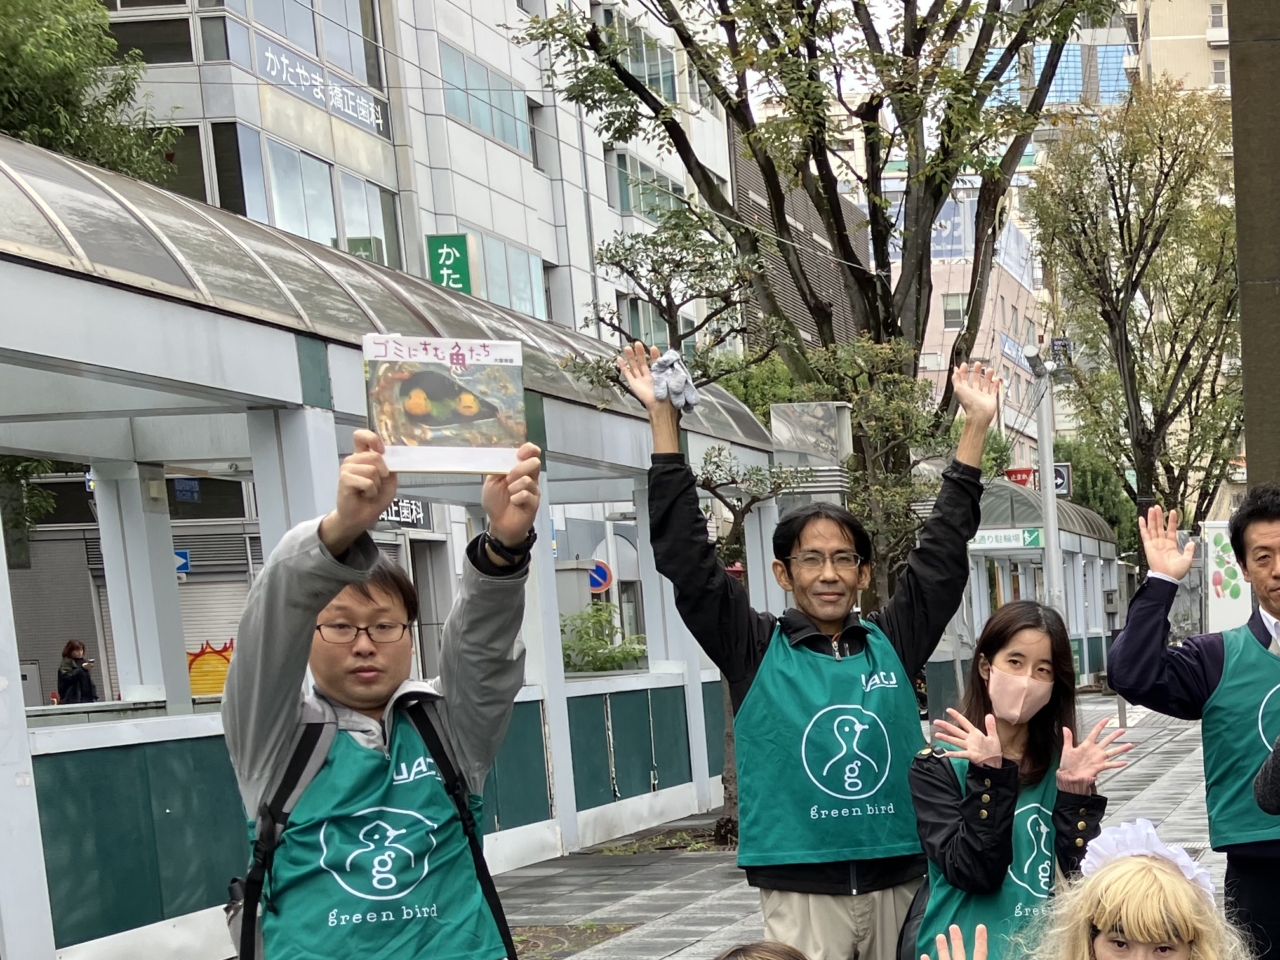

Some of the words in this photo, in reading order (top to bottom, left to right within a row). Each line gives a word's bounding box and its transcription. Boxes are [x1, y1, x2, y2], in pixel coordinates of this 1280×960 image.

[264, 46, 383, 132] かたやま矯正歯科
[437, 243, 463, 288] かた
[373, 340, 490, 371] ゴミにすむ魚たち
[378, 498, 424, 525] 正歯科
[971, 533, 1020, 545] 通り駐輪場
[393, 756, 442, 785] UAC
[810, 805, 862, 820] green
[866, 803, 895, 815] bird
[328, 909, 395, 927] green
[401, 904, 438, 920] bird
